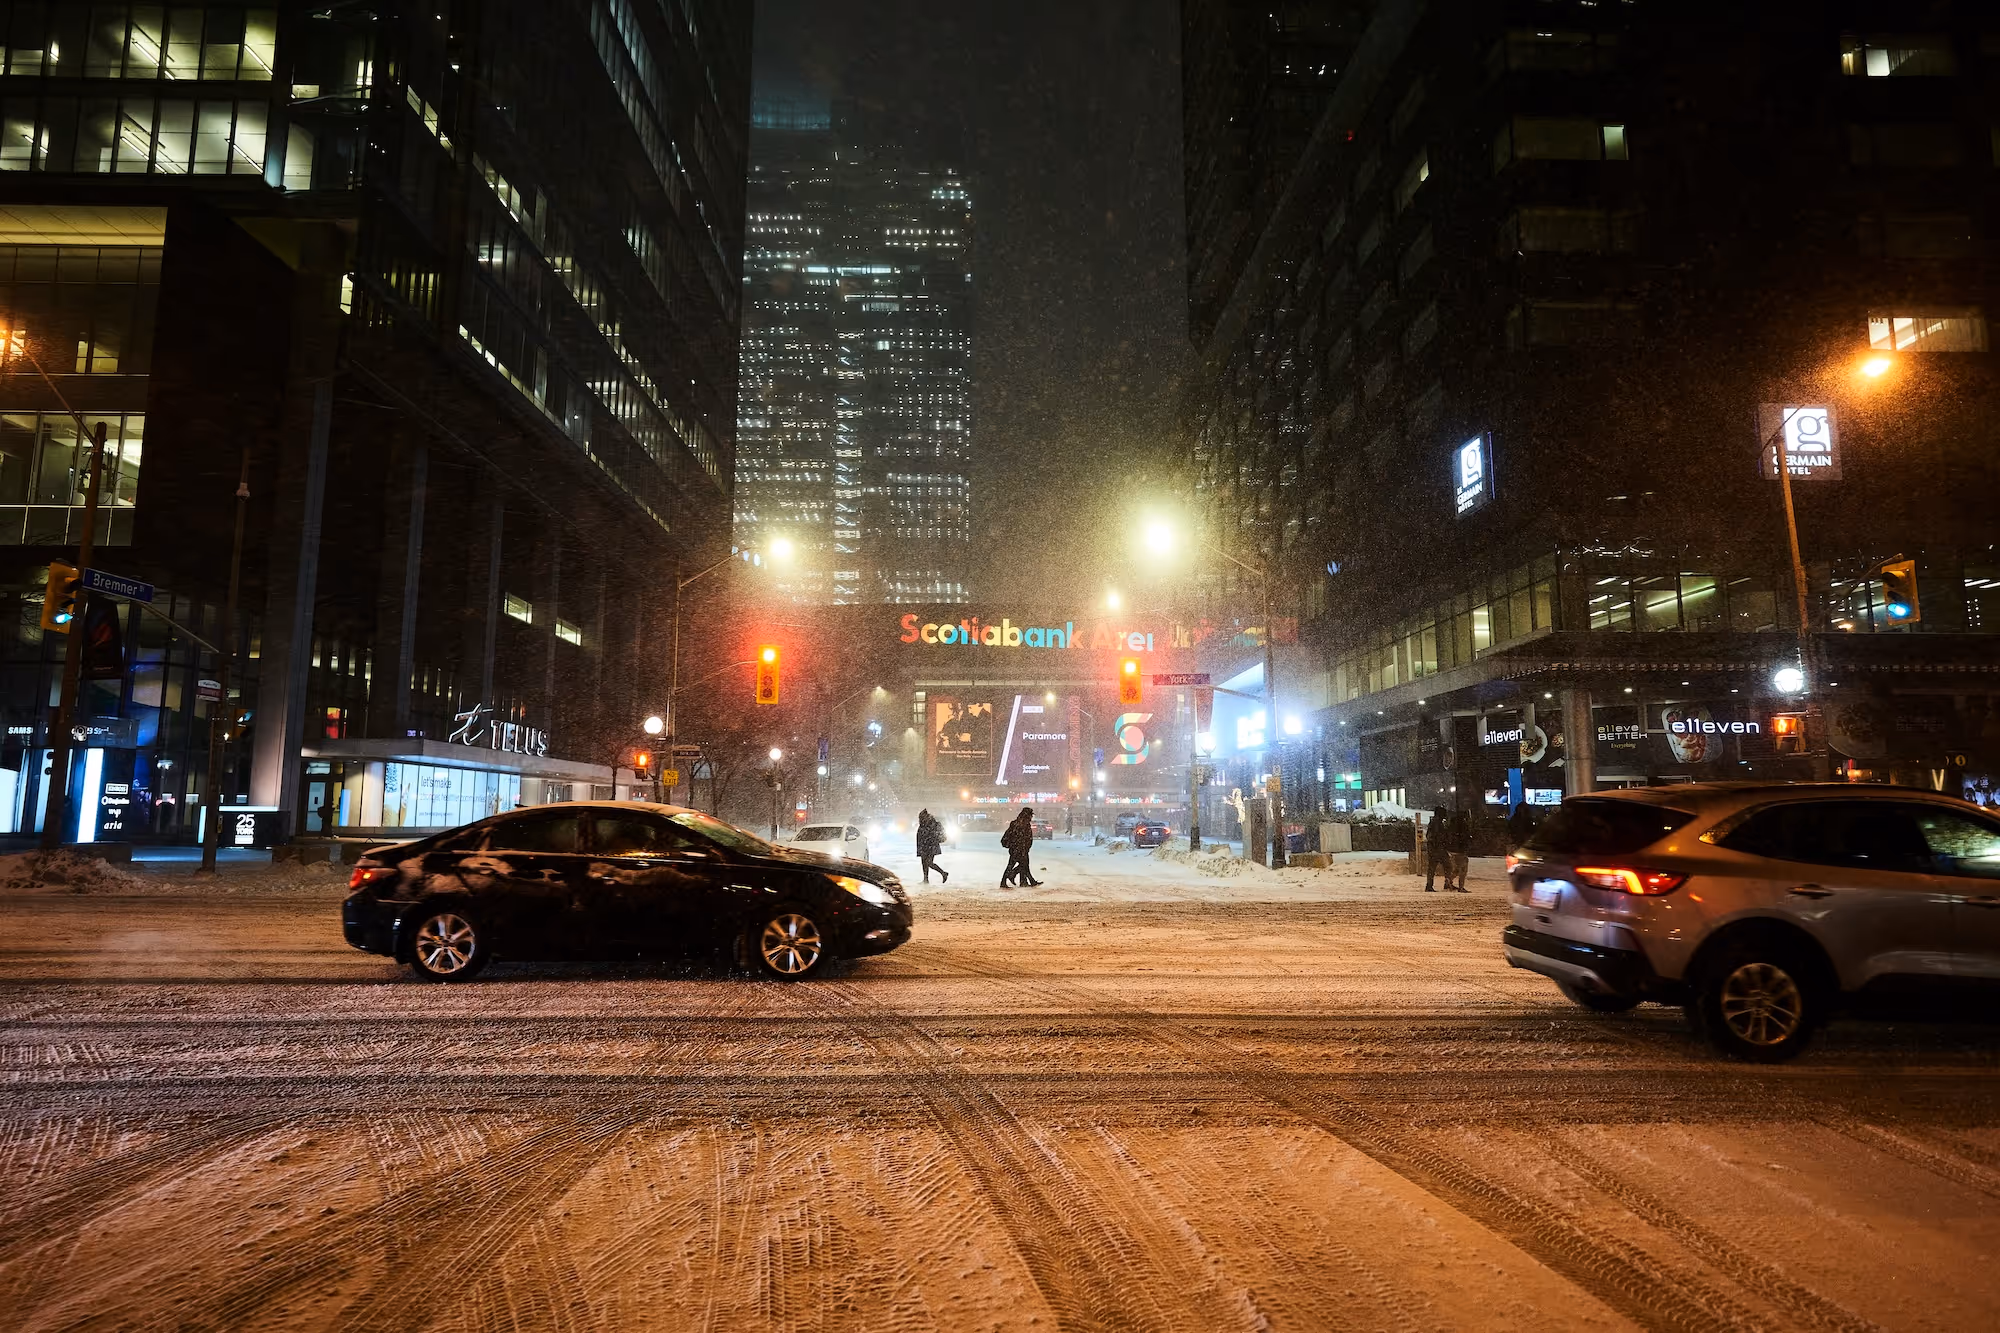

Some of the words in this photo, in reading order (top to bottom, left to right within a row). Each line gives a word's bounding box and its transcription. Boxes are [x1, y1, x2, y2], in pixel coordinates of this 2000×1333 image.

[1457, 482, 1483, 505] GERMAIN
[93, 573, 138, 596] Bremner
[900, 613, 1084, 649] Scotiabank
[1169, 675, 1188, 684] York
[490, 719, 547, 758] TELUS
[1023, 732, 1067, 741] Paramore
[103, 820, 122, 830] aria
[236, 814, 255, 828] 25
